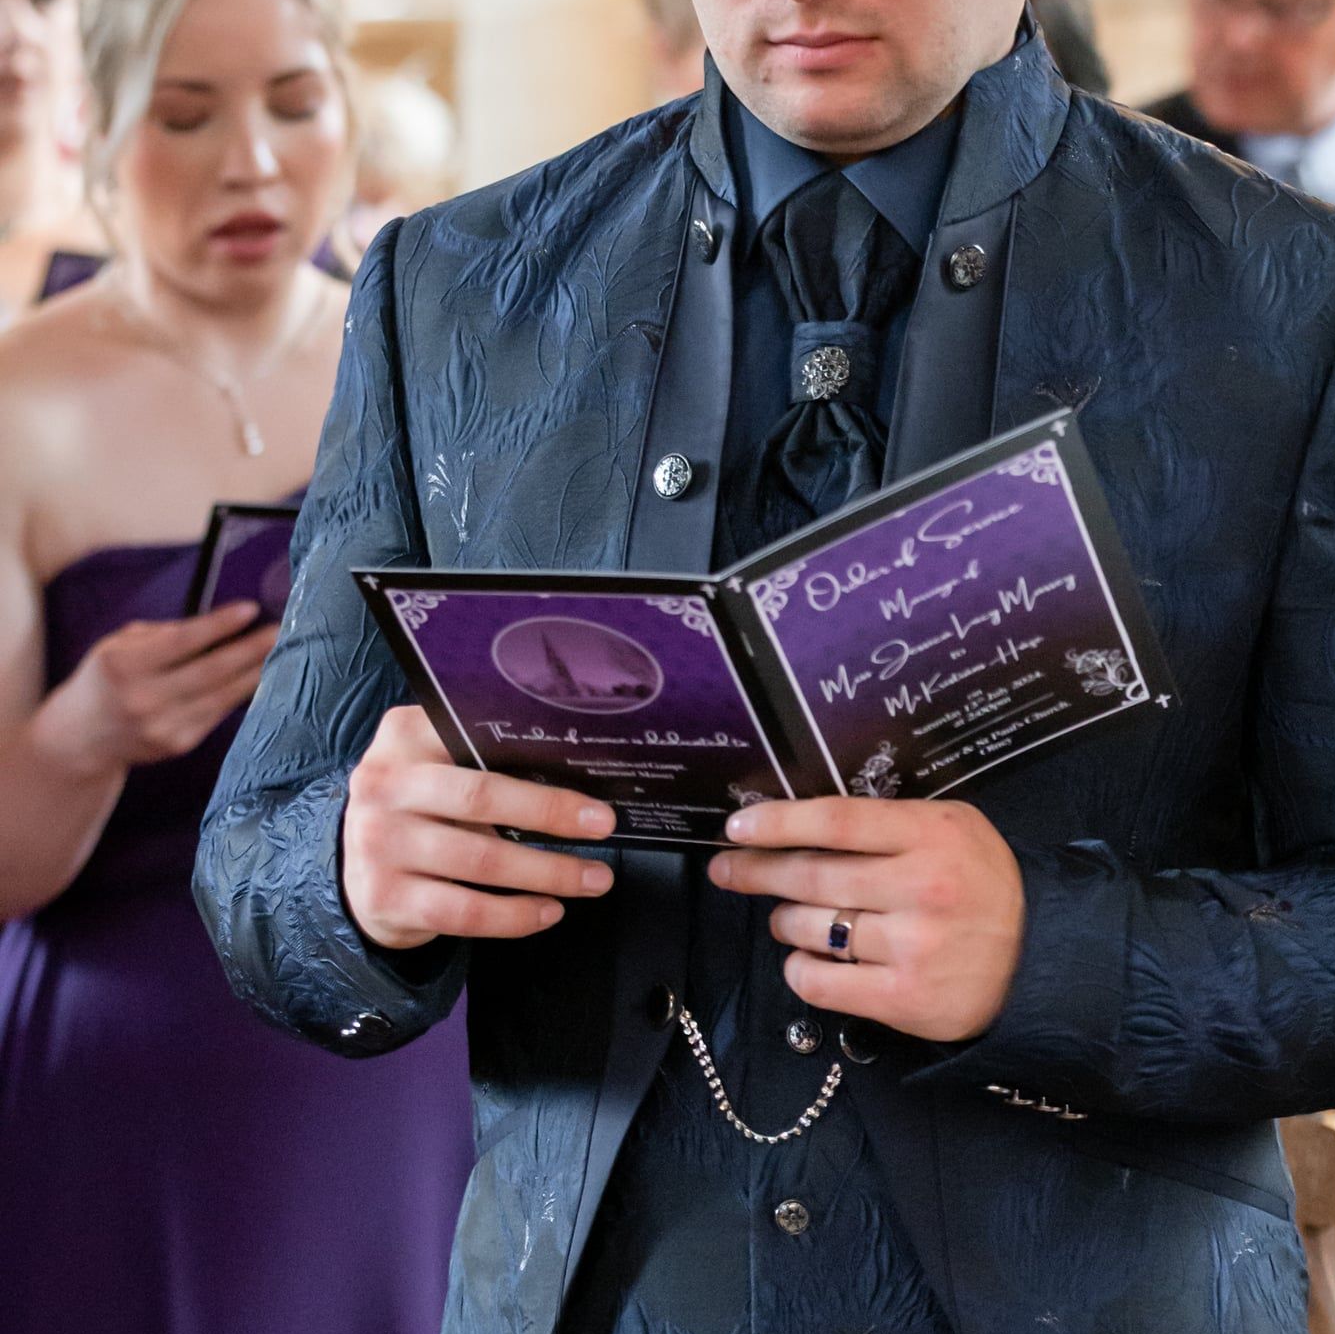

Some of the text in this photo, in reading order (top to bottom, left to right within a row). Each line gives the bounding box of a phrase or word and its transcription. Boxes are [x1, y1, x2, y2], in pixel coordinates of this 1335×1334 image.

[805, 499, 1023, 611] Order of Service
